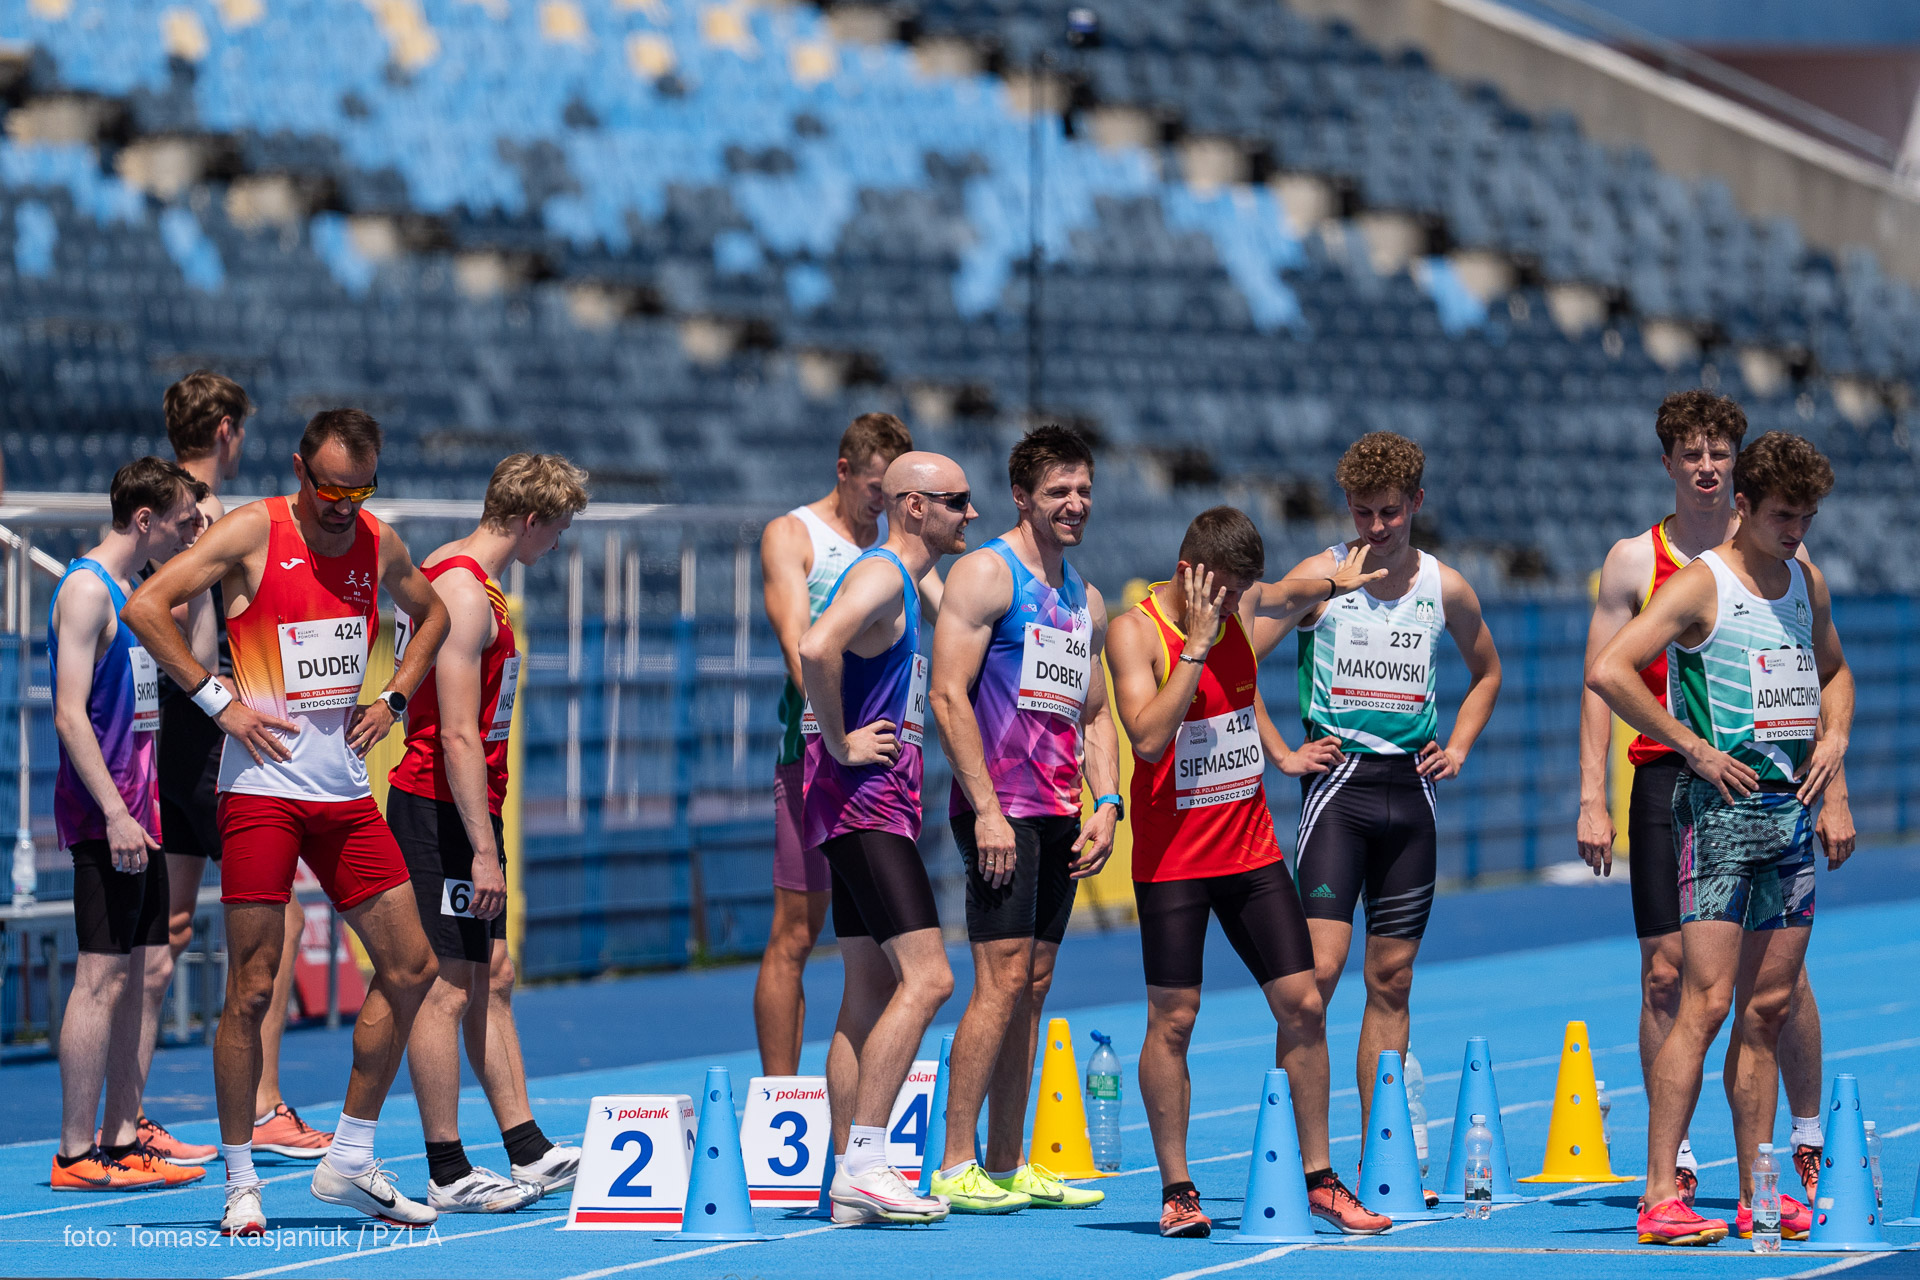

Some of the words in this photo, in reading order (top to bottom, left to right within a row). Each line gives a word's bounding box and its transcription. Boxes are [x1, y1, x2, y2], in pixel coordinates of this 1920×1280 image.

[335, 622, 362, 640] 424
[396, 621, 406, 655] 7
[1390, 631, 1422, 649] 237
[1066, 638, 1086, 658] 266
[298, 654, 360, 679] DUDEK
[1336, 658, 1425, 683] MAKOWSKI
[1796, 655, 1813, 671] 210
[1036, 661, 1083, 690] DOBEK
[300, 698, 348, 709] BYDGOSZCZ
[1343, 698, 1397, 709] BYDGOSZCZ
[1397, 703, 1414, 711] 2024
[1370, 691, 1401, 700] Mistrzostwa
[1758, 687, 1819, 708] ADAMCZEWSKI
[1031, 701, 1070, 715] BYDGOSZCZ
[1226, 714, 1251, 734] 412
[1767, 730, 1809, 738] BYDGOSZCZ
[1180, 744, 1260, 778] SIEMASZKO
[1190, 792, 1240, 806] BYDGOSZCZ
[450, 883, 470, 913] 6
[906, 1072, 936, 1082] olan
[775, 1088, 826, 1102] polanik
[618, 1107, 670, 1121] polanik
[890, 1094, 928, 1156] 4
[768, 1111, 809, 1177] 3
[608, 1130, 653, 1197] 2
